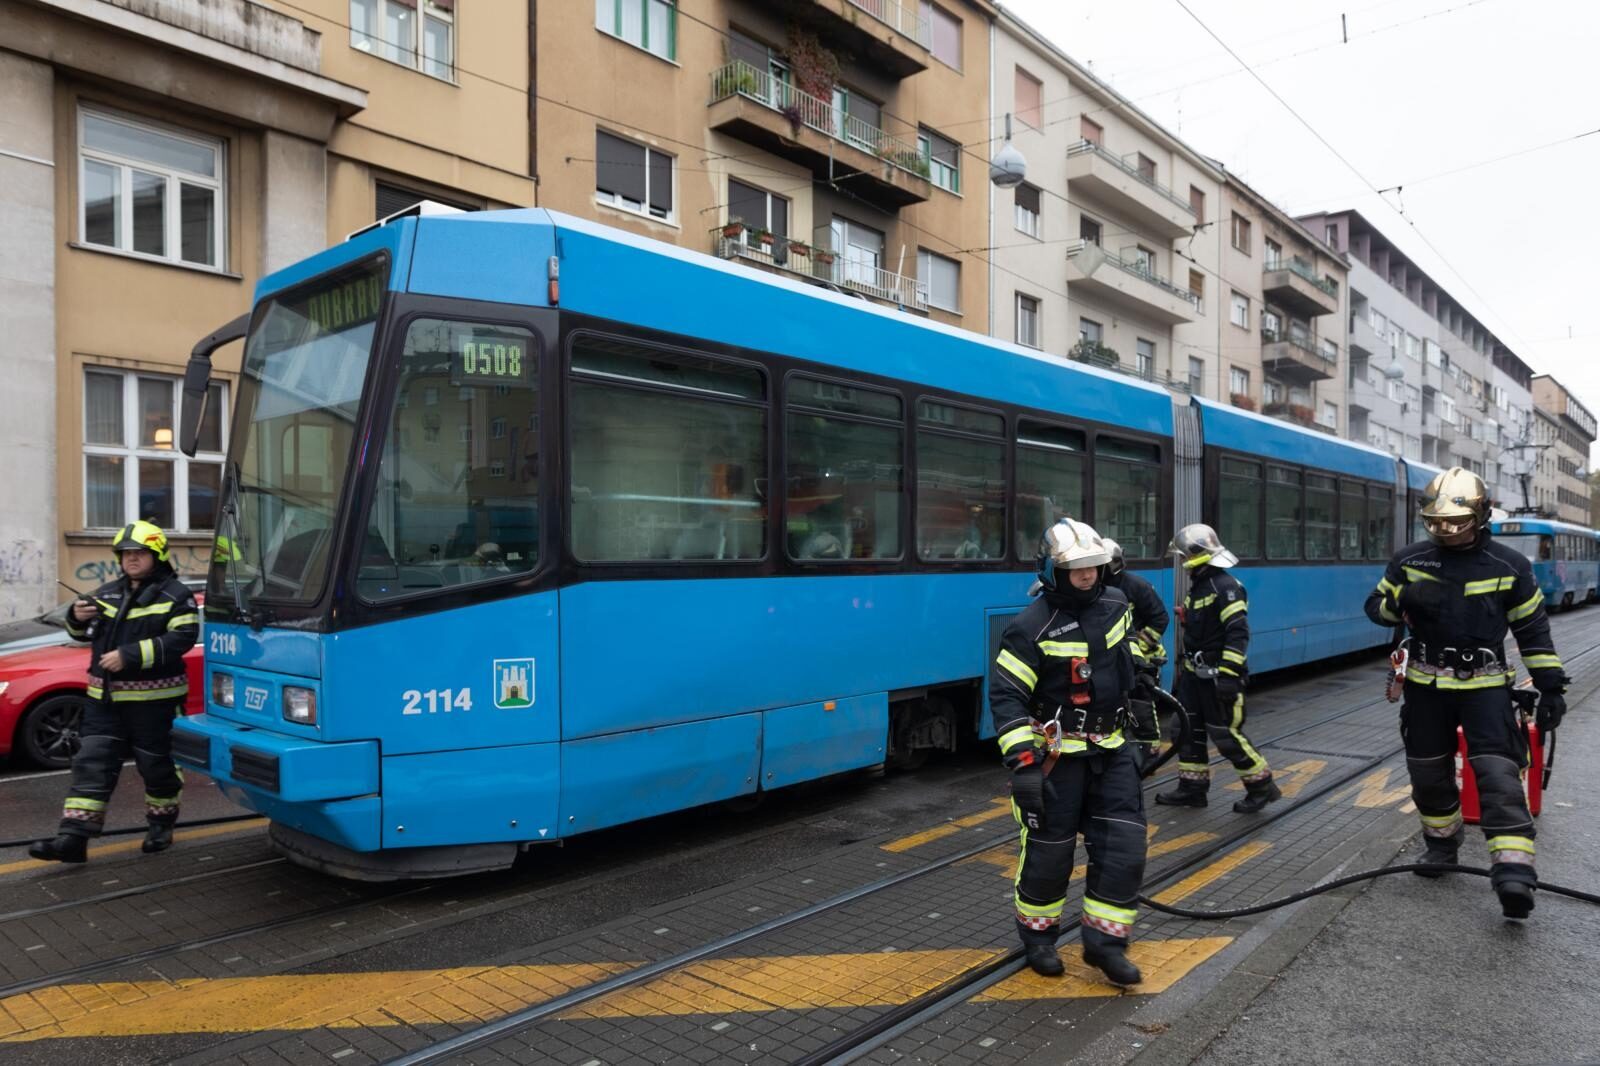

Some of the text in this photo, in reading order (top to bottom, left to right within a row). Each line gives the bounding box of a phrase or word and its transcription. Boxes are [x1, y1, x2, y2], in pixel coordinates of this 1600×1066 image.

[463, 342, 521, 377] 0508
[210, 631, 237, 656] 2114
[402, 687, 473, 715] 2114
